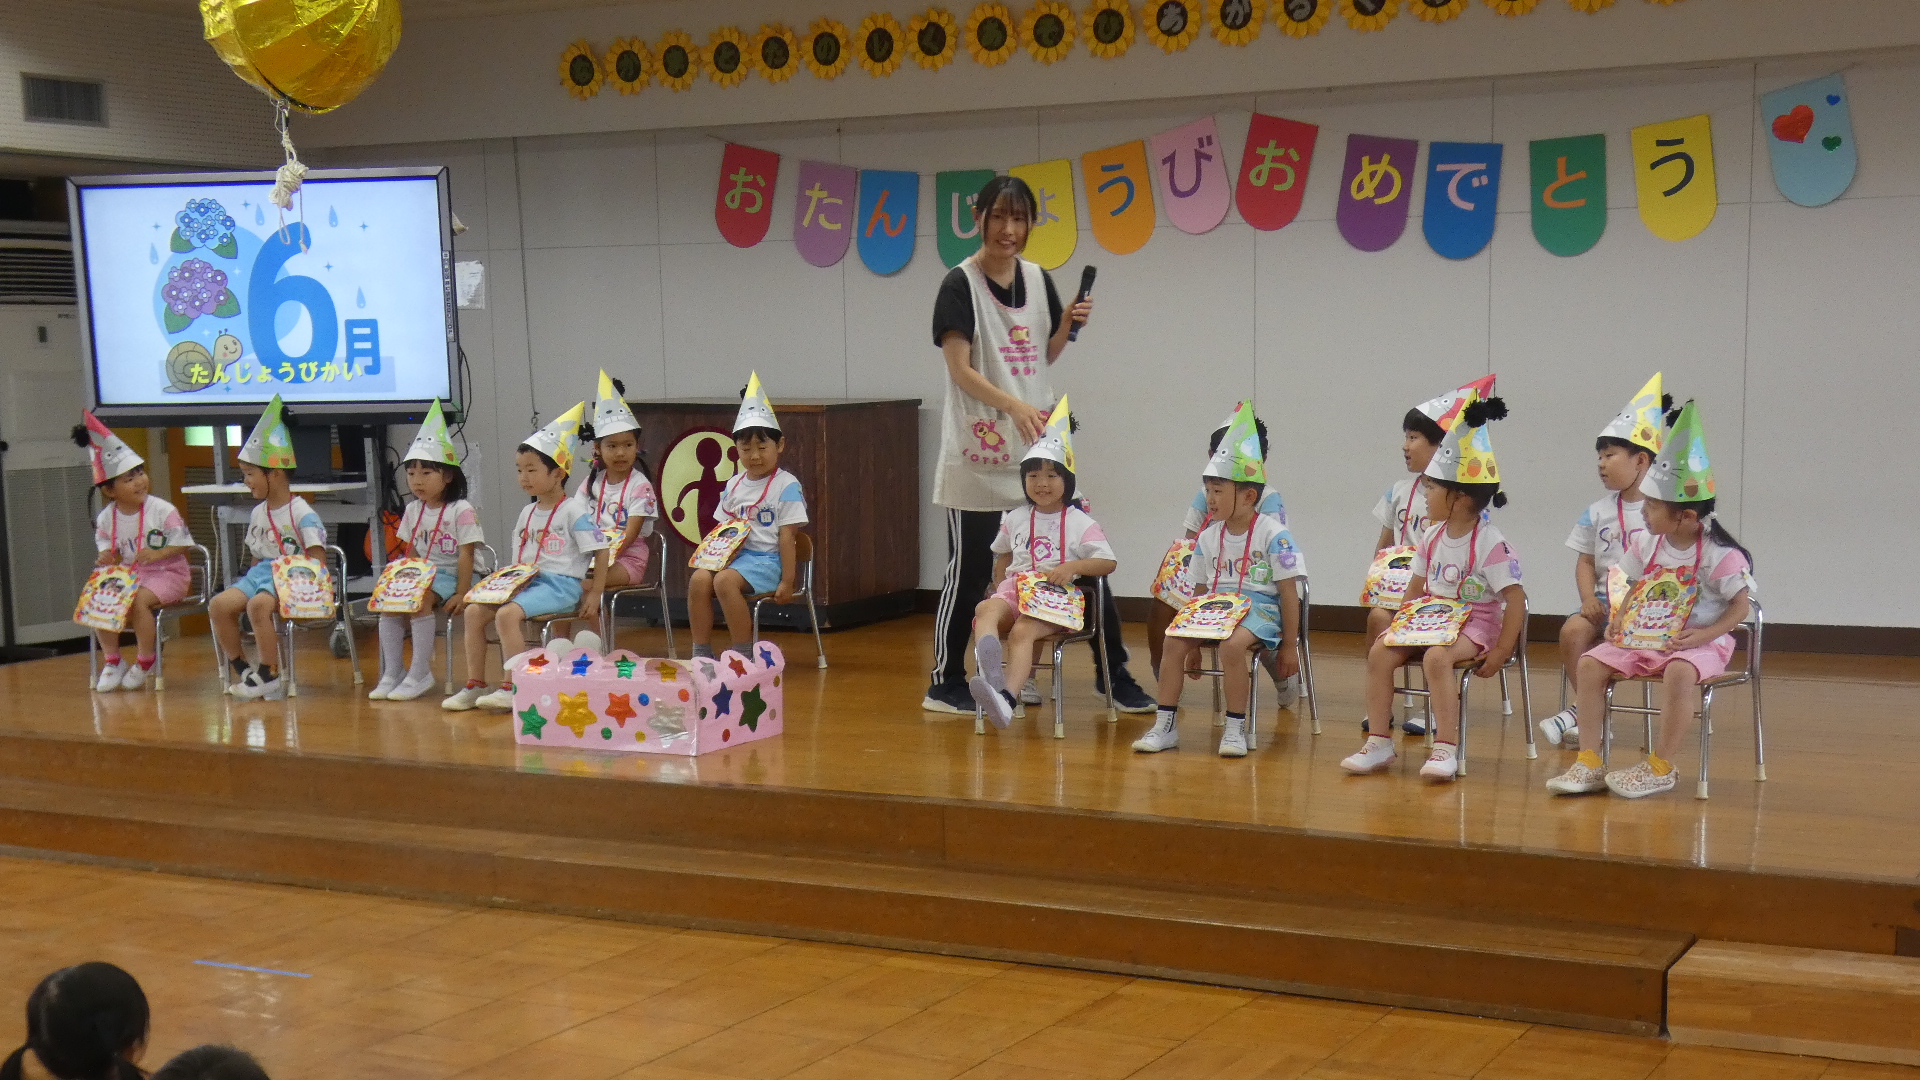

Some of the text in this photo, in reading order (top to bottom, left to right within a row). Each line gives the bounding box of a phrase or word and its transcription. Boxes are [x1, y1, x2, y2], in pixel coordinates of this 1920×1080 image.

[190, 361, 363, 385] たんじょうびかい
